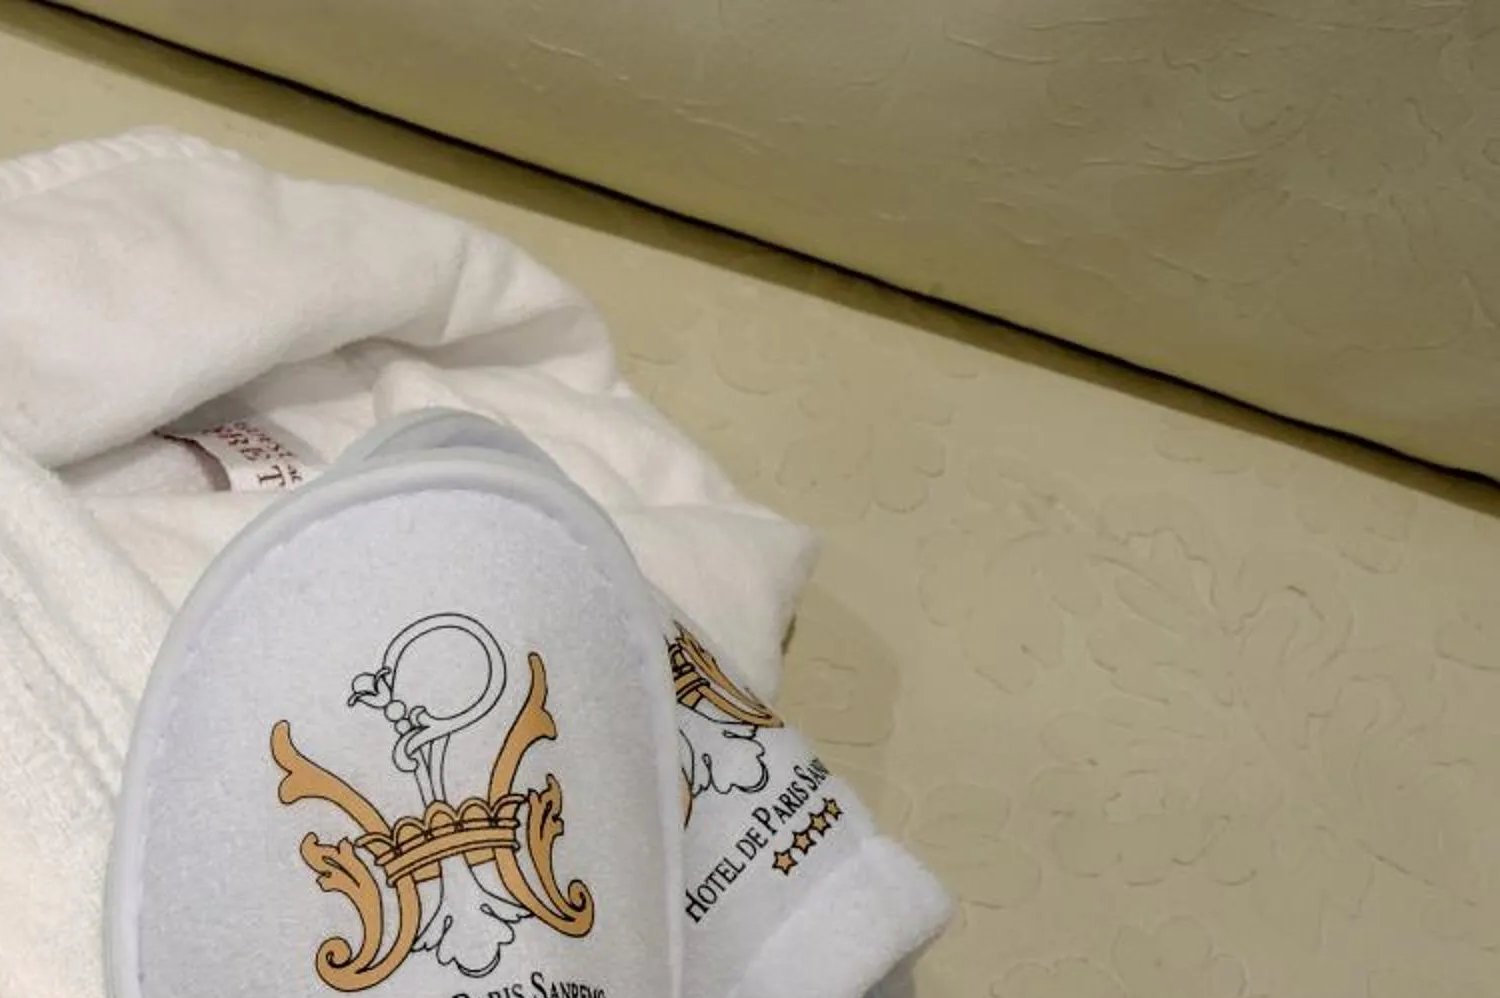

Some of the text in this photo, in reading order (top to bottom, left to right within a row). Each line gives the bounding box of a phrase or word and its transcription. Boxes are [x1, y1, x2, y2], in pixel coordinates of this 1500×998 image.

[684, 857, 746, 924] HOTEL
[735, 826, 769, 860] DE
[752, 780, 809, 837] PARIS
